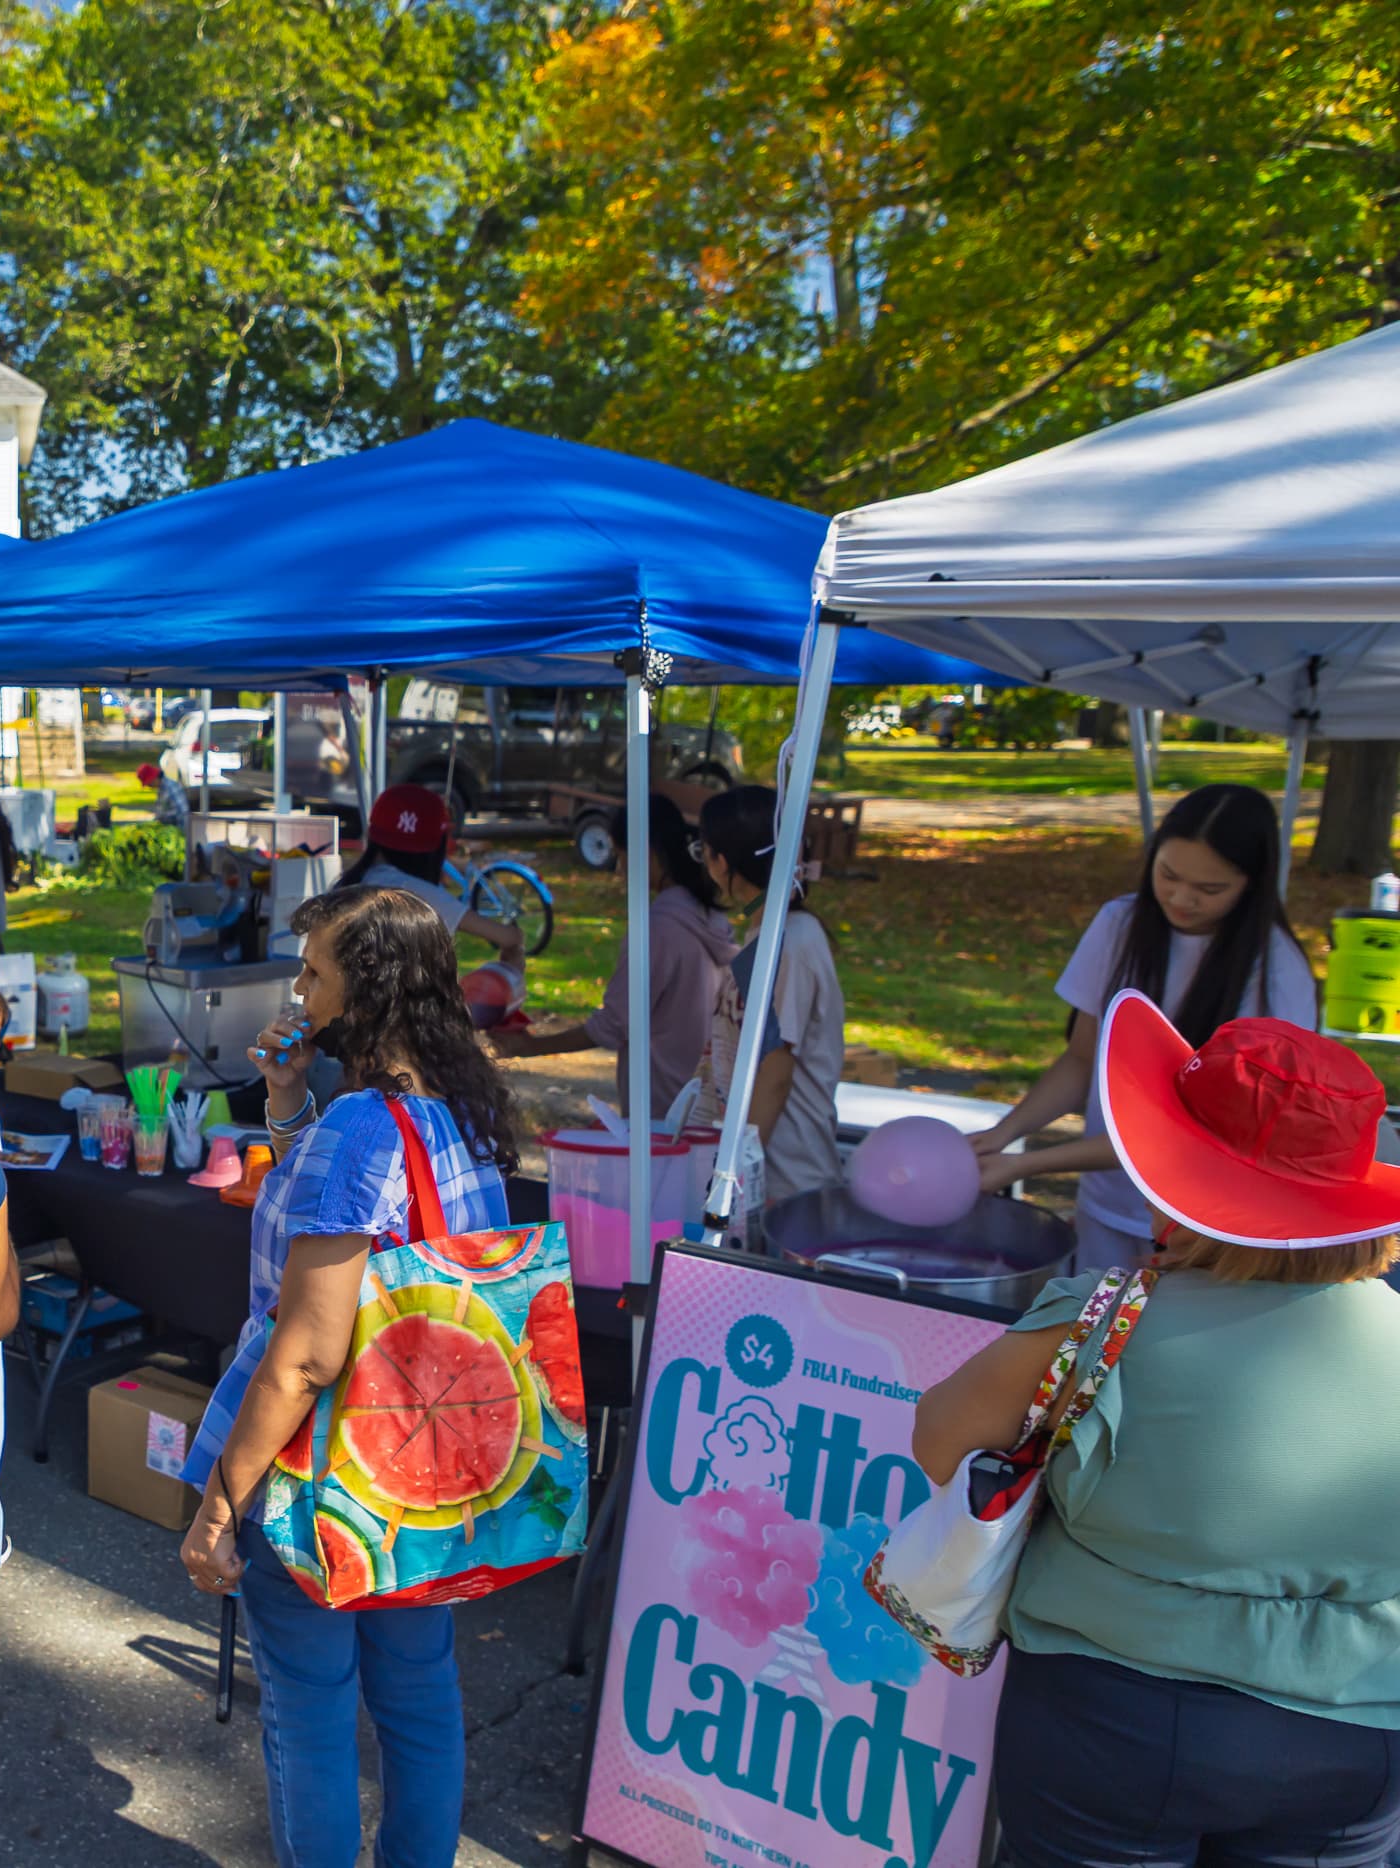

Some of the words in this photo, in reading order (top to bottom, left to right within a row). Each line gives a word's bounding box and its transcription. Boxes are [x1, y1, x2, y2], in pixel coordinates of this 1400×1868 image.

[740, 1333, 775, 1371] $4
[801, 1358, 838, 1384] FBLA
[840, 1368, 923, 1404] Fundraiser
[623, 1602, 977, 1868] Candy
[618, 1784, 639, 1802] ALL
[640, 1793, 696, 1828] PROCEEDS
[697, 1819, 712, 1835] GO
[715, 1825, 729, 1842] TO
[731, 1832, 792, 1868] NORTHERN
